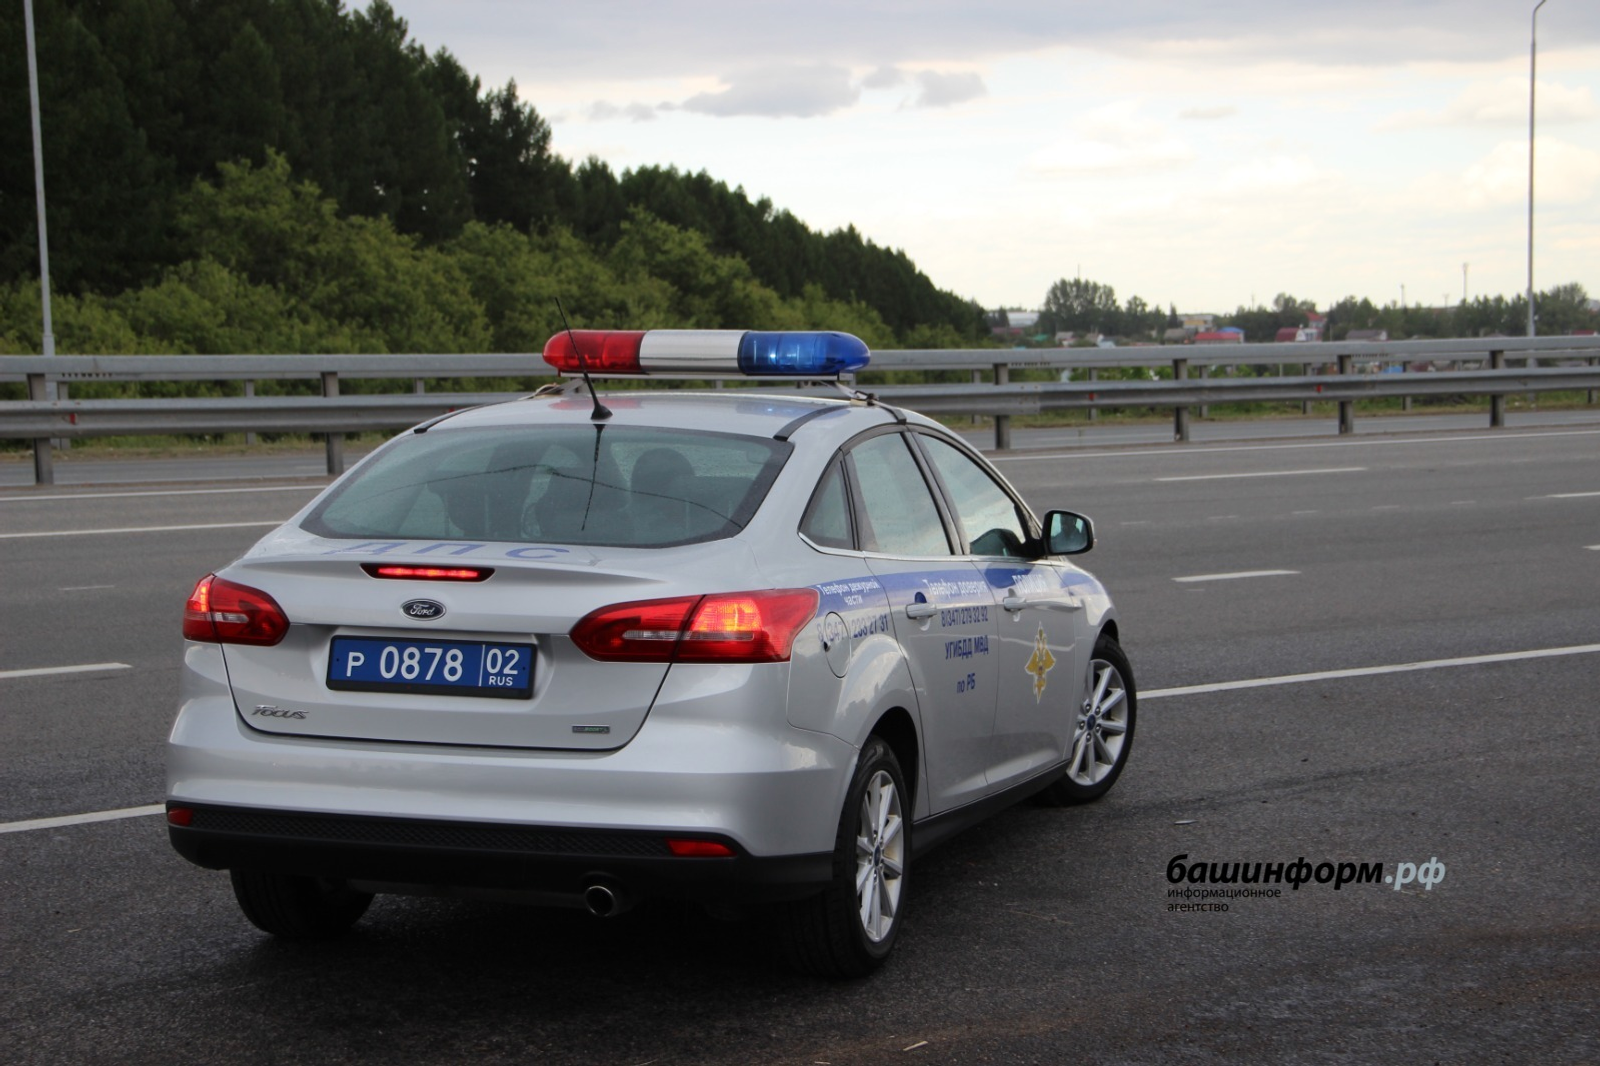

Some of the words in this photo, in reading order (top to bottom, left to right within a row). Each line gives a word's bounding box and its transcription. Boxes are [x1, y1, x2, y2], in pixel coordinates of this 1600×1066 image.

[323, 542, 570, 559] ДПС
[816, 584, 850, 596] Телефон
[849, 580, 880, 593] дежурной
[922, 579, 959, 599] Телефон
[844, 595, 863, 605] части
[410, 603, 435, 616] Ford
[961, 608, 972, 624] 279
[973, 607, 980, 623] 32
[981, 606, 988, 622] 92
[878, 613, 889, 632] 31
[945, 638, 973, 660] УГИБДД
[973, 635, 989, 655] МВД
[379, 645, 464, 682] 0878
[485, 648, 520, 675] 02
[488, 676, 514, 687] RUS
[956, 680, 965, 694] по
[966, 673, 976, 691] РБ
